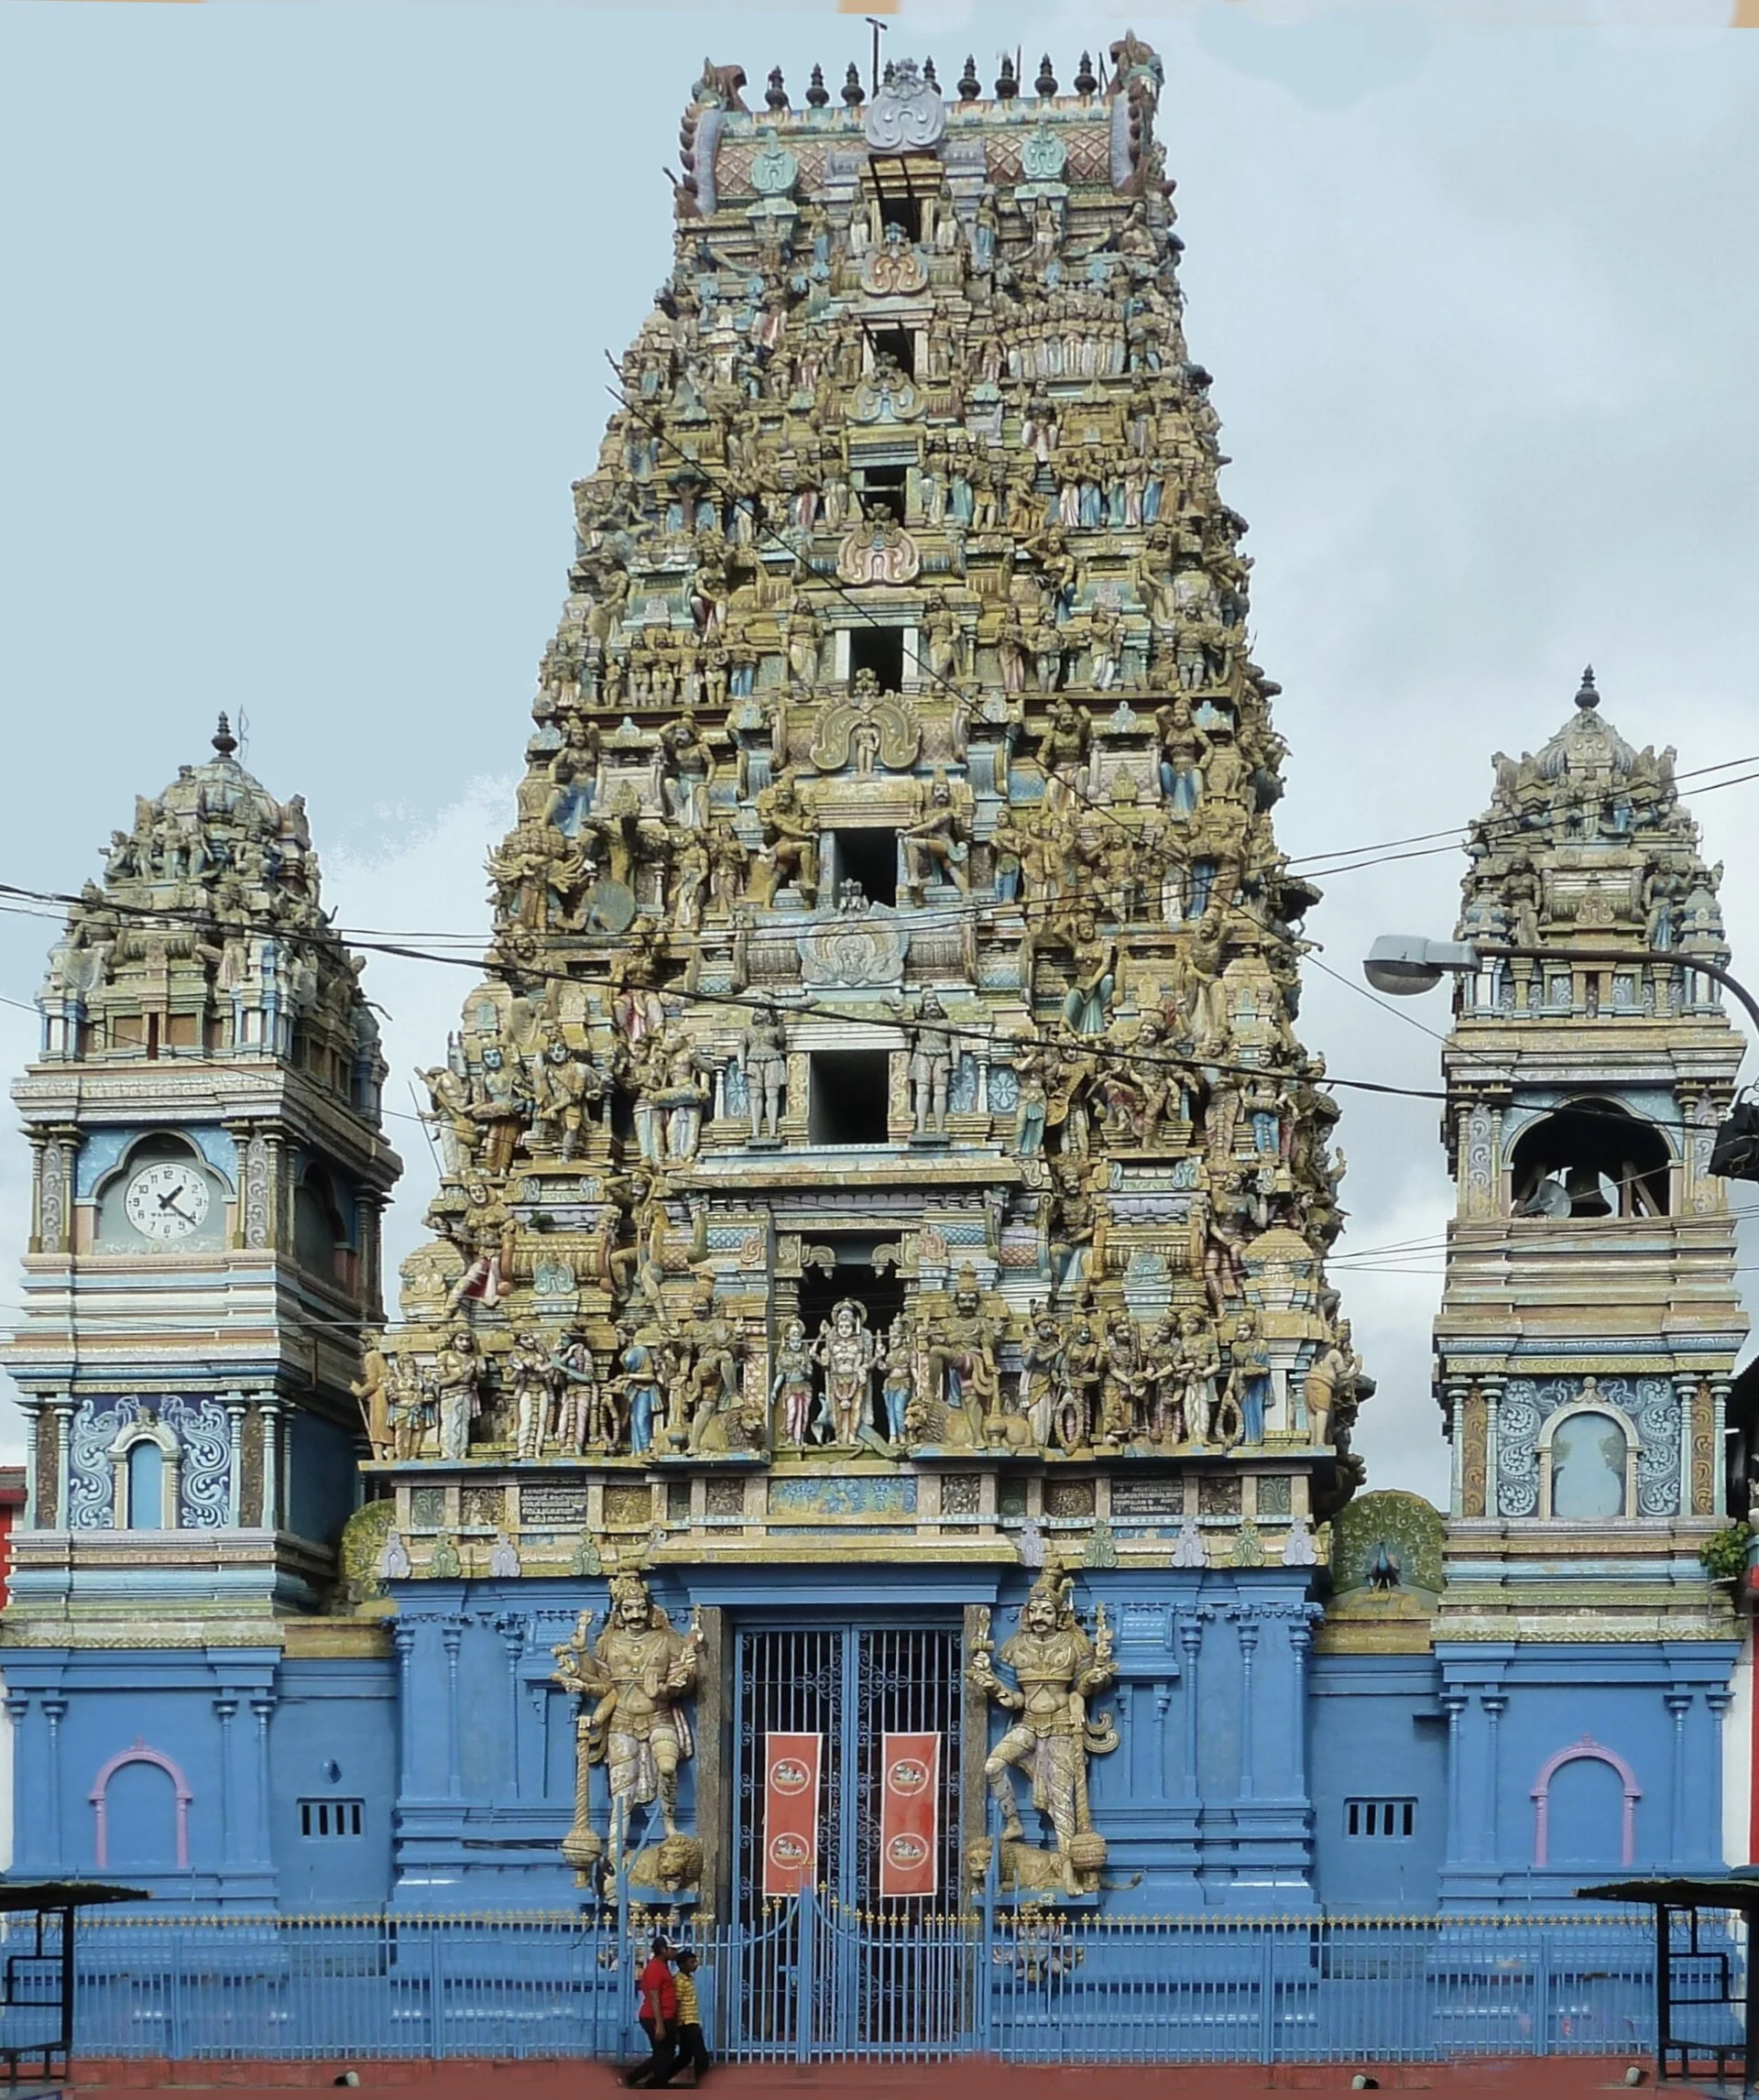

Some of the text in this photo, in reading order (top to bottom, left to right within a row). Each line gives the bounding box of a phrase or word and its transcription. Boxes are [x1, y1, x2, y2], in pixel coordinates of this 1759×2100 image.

[150, 1175, 158, 1184] 11
[163, 1171, 173, 1179] 12
[182, 1175, 187, 1184] 1
[138, 1185, 148, 1194] 10
[191, 1185, 198, 1193] 2
[133, 1198, 140, 1207] 9
[195, 1198, 202, 1207] 3
[190, 1211, 196, 1220] 4
[149, 1221, 156, 1230] 7
[163, 1225, 170, 1234] 6
[178, 1220, 185, 1230] 5
